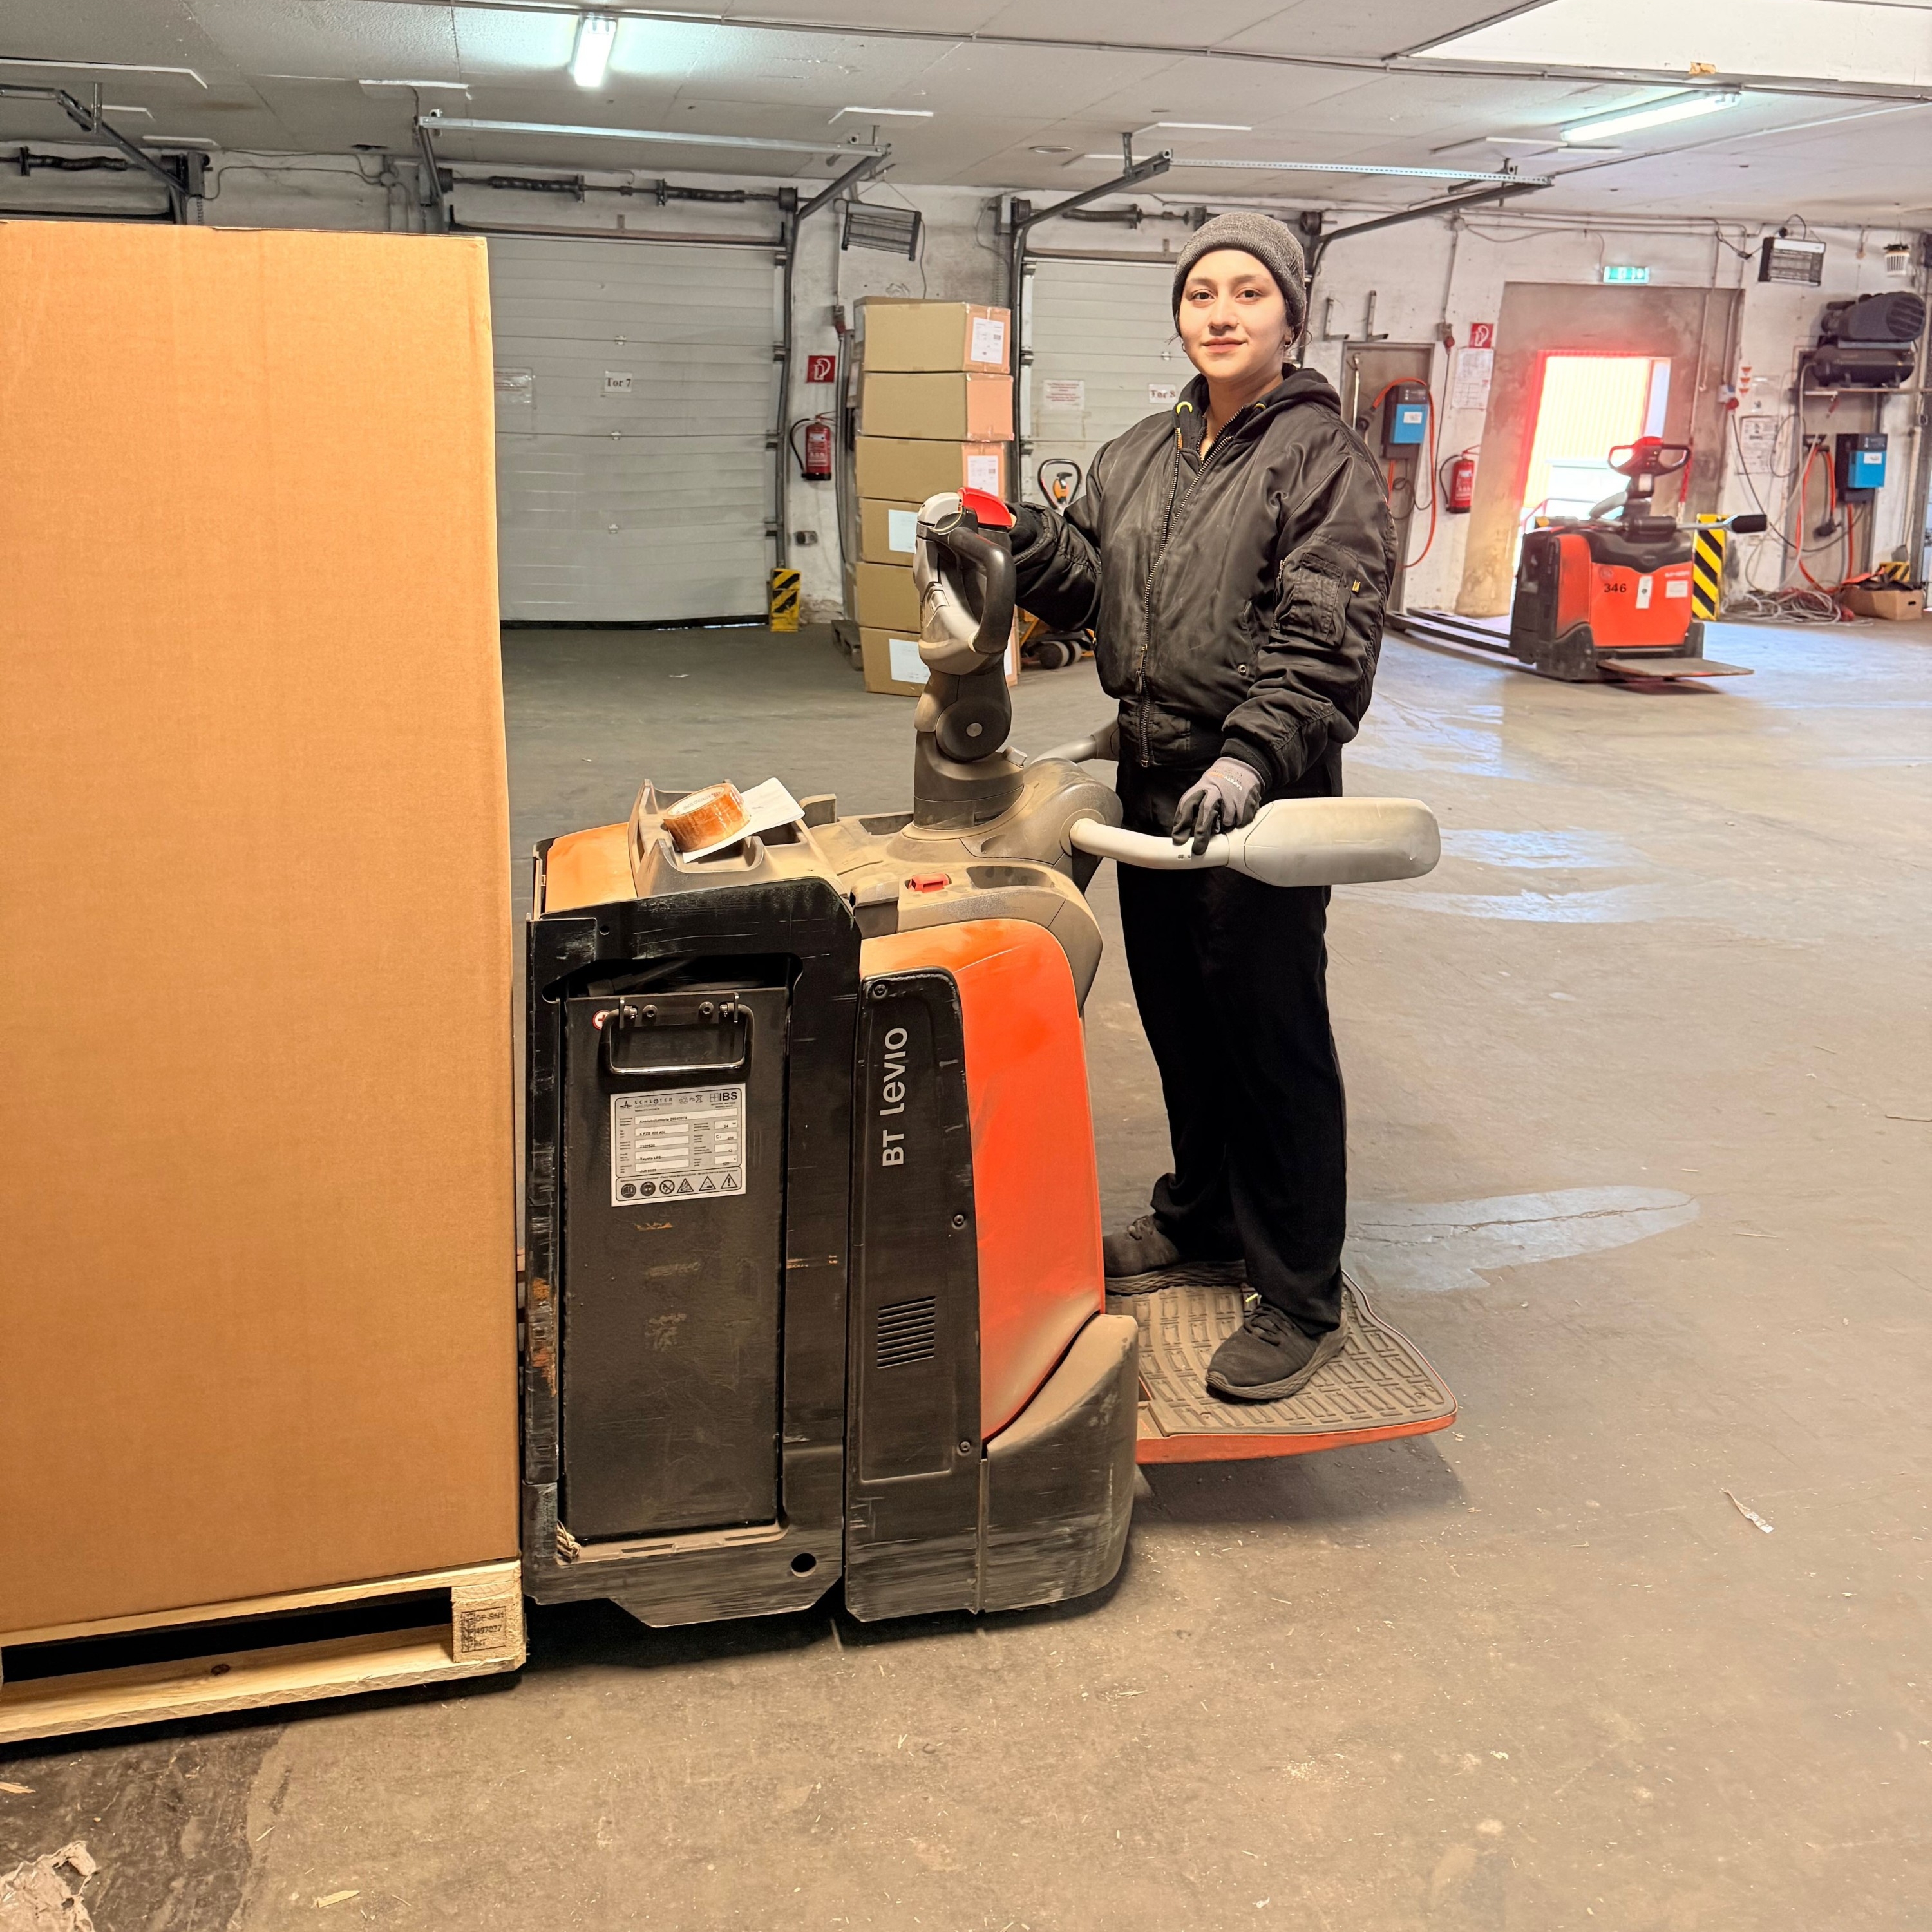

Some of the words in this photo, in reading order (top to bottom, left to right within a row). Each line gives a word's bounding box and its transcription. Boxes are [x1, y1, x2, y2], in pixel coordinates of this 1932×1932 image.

[605, 377, 623, 387] Tor
[626, 378, 631, 387] 7
[1150, 390, 1168, 398] Tor
[1604, 583, 1627, 592] 346
[719, 1091, 737, 1101] IBS
[882, 1130, 904, 1166] BT
